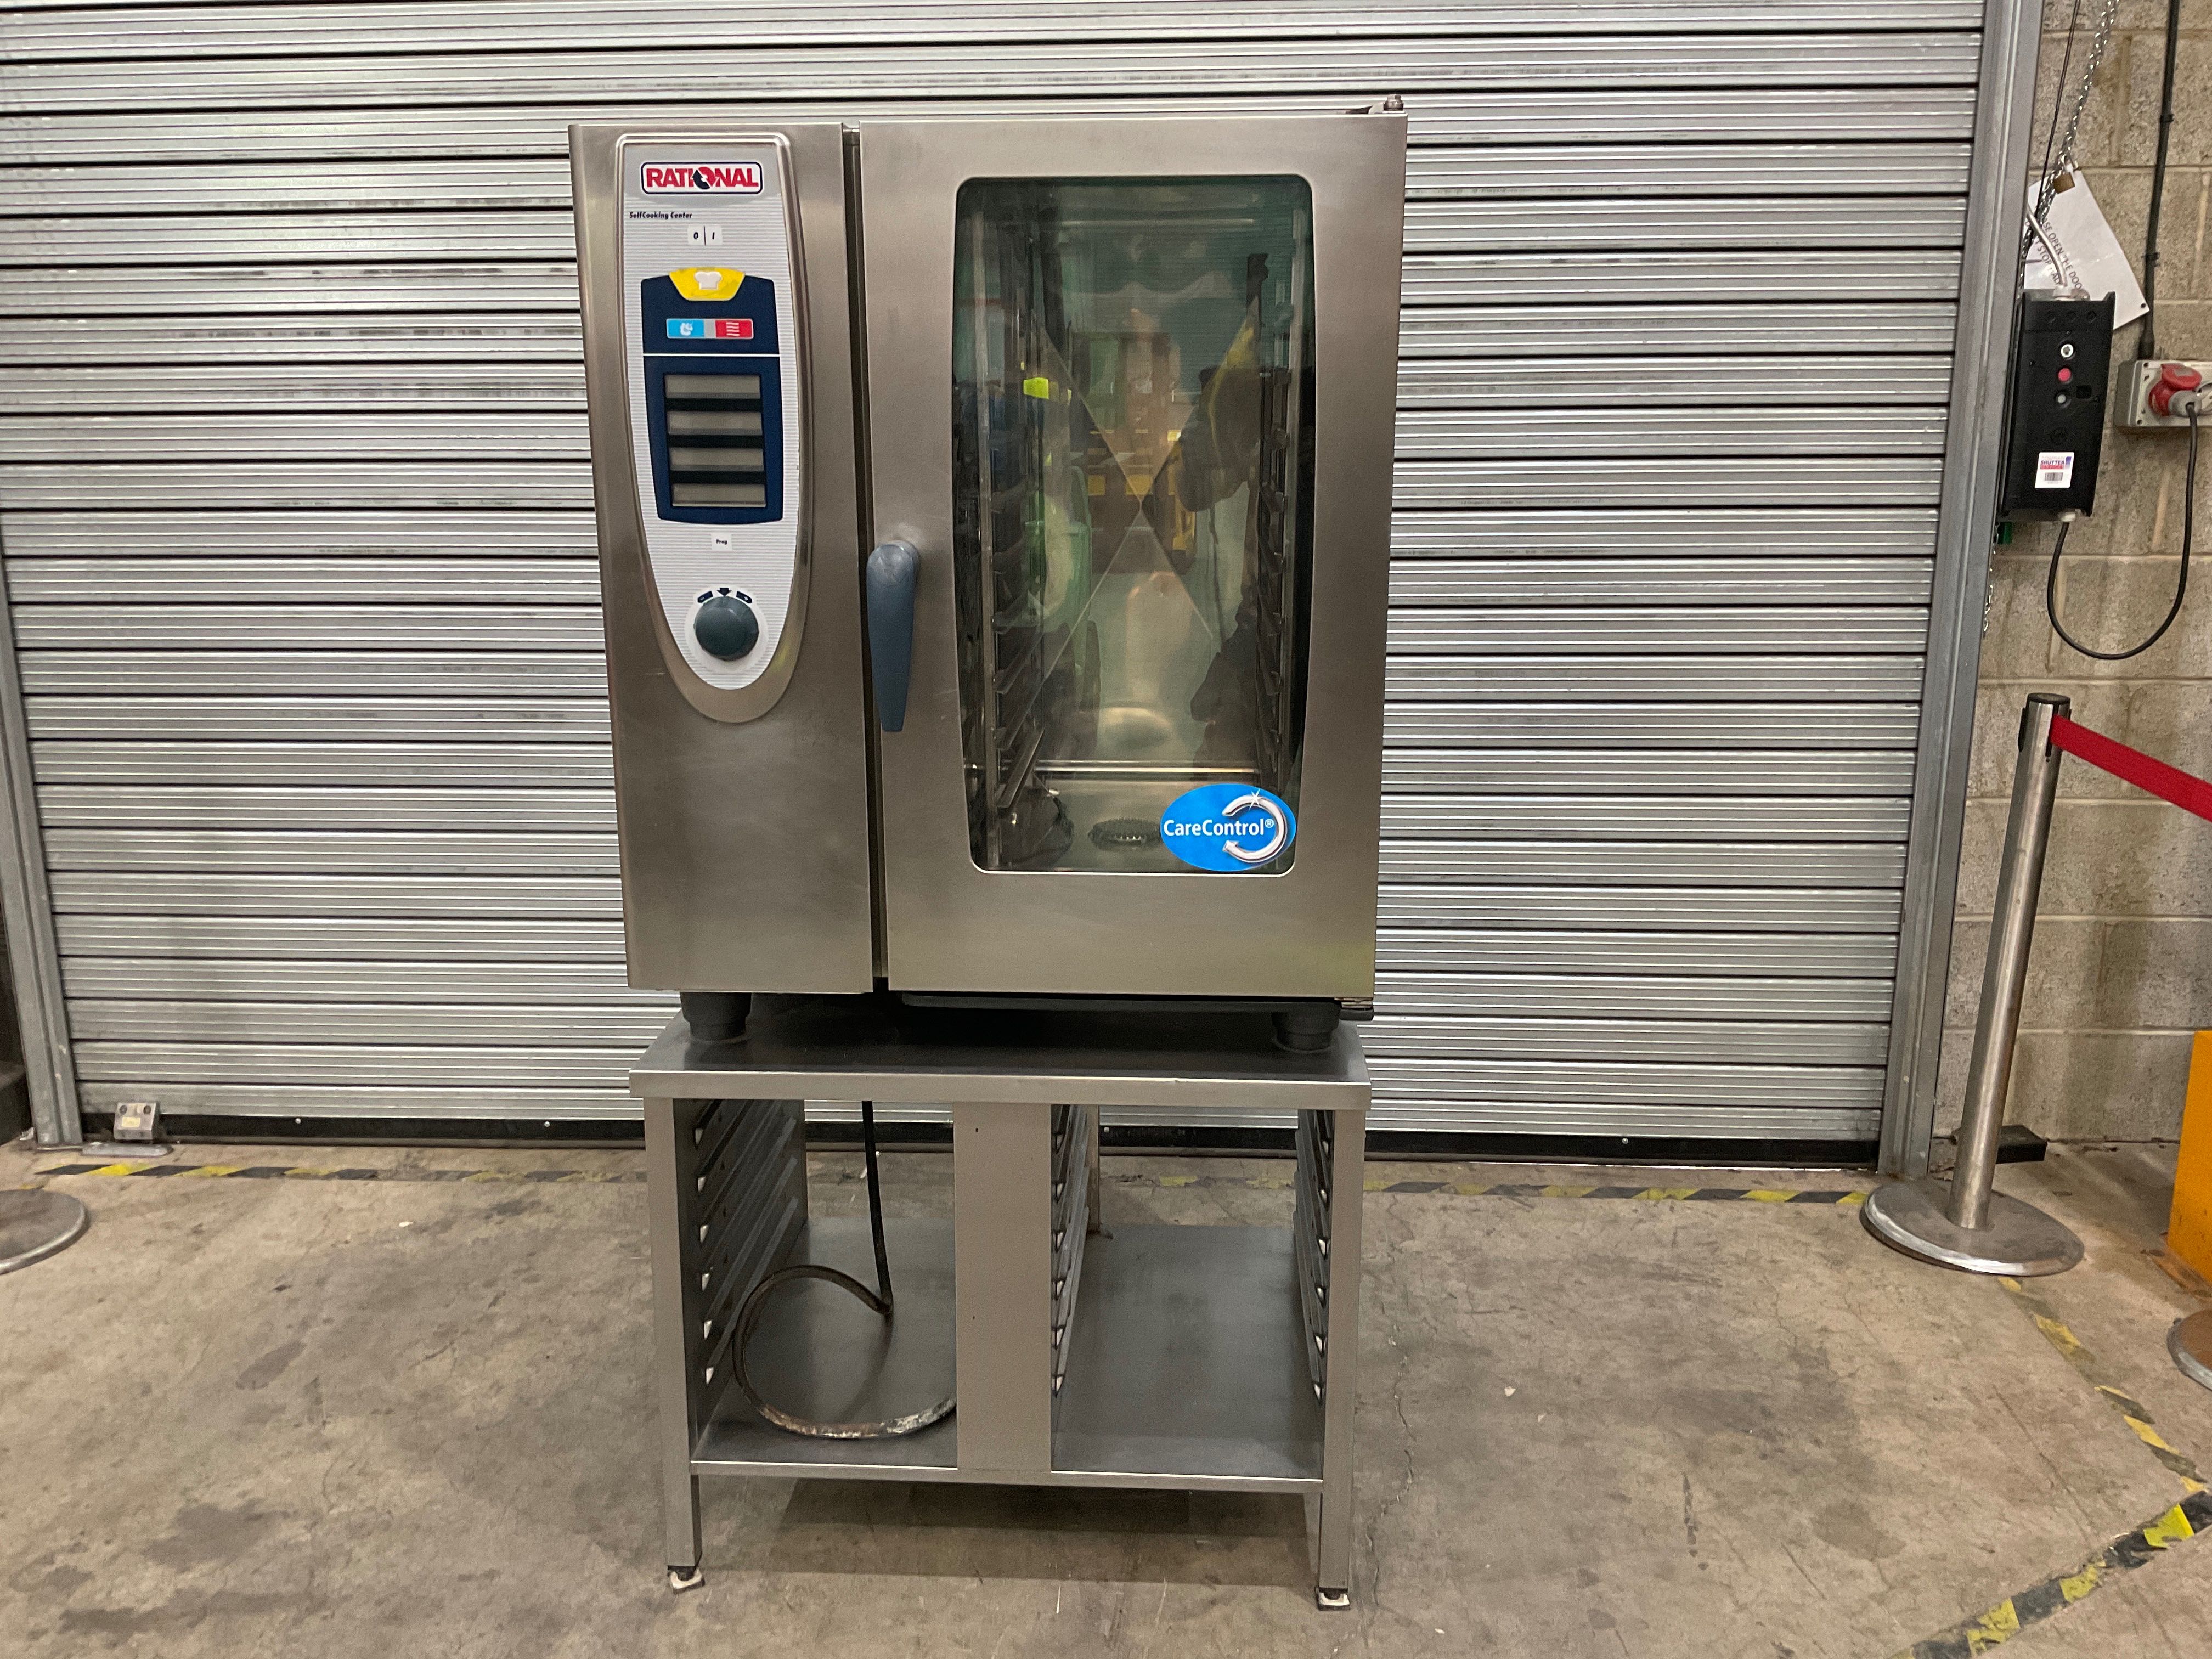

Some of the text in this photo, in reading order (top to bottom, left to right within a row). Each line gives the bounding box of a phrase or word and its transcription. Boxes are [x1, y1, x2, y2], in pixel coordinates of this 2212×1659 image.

[646, 166, 759, 190] RATIONAL
[629, 211, 692, 220] SelfCooking Center
[2037, 245, 2052, 265] STOP
[2049, 233, 2064, 255] OPEN
[2068, 270, 2083, 290] DOO
